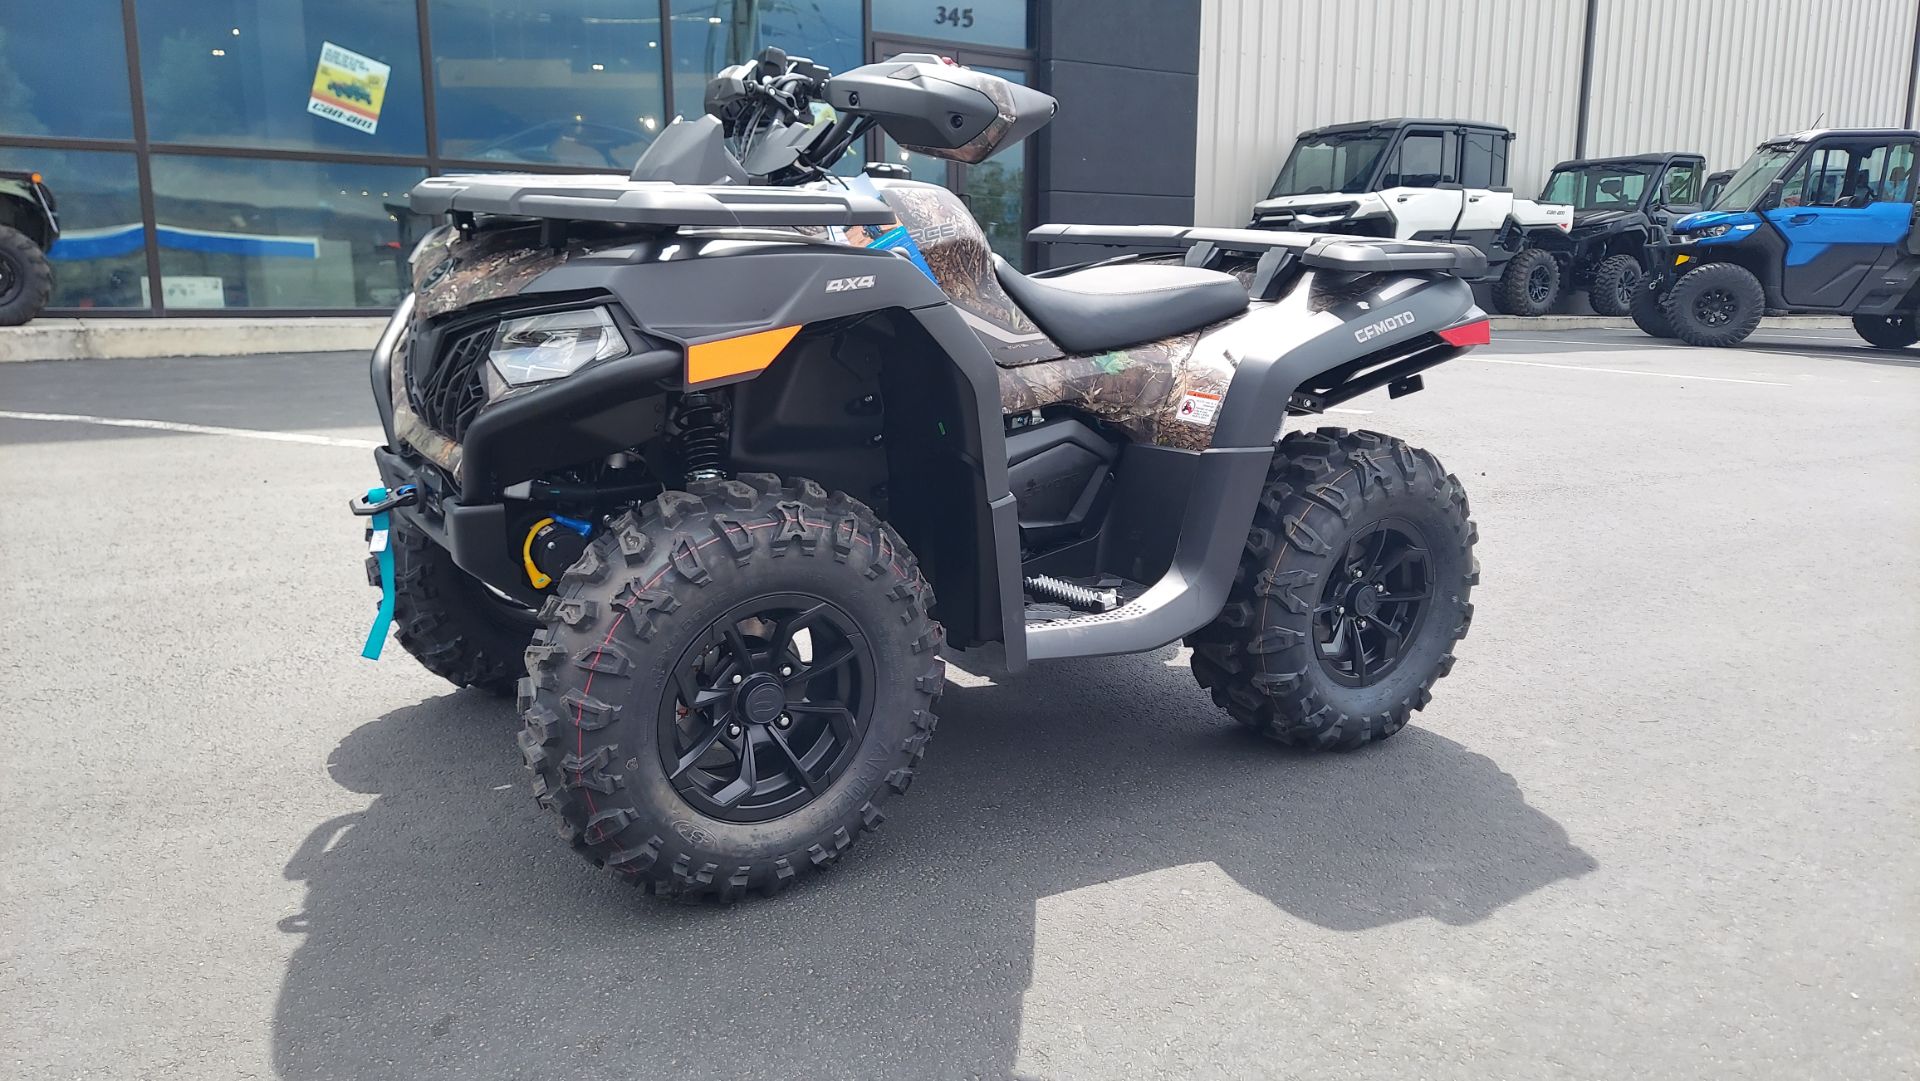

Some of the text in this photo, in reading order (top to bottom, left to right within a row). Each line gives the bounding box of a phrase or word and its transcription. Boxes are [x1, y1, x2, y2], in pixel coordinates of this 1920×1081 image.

[933, 6, 974, 28] 345
[825, 275, 876, 293] 4X4
[1354, 311, 1416, 343] CFMOTO
